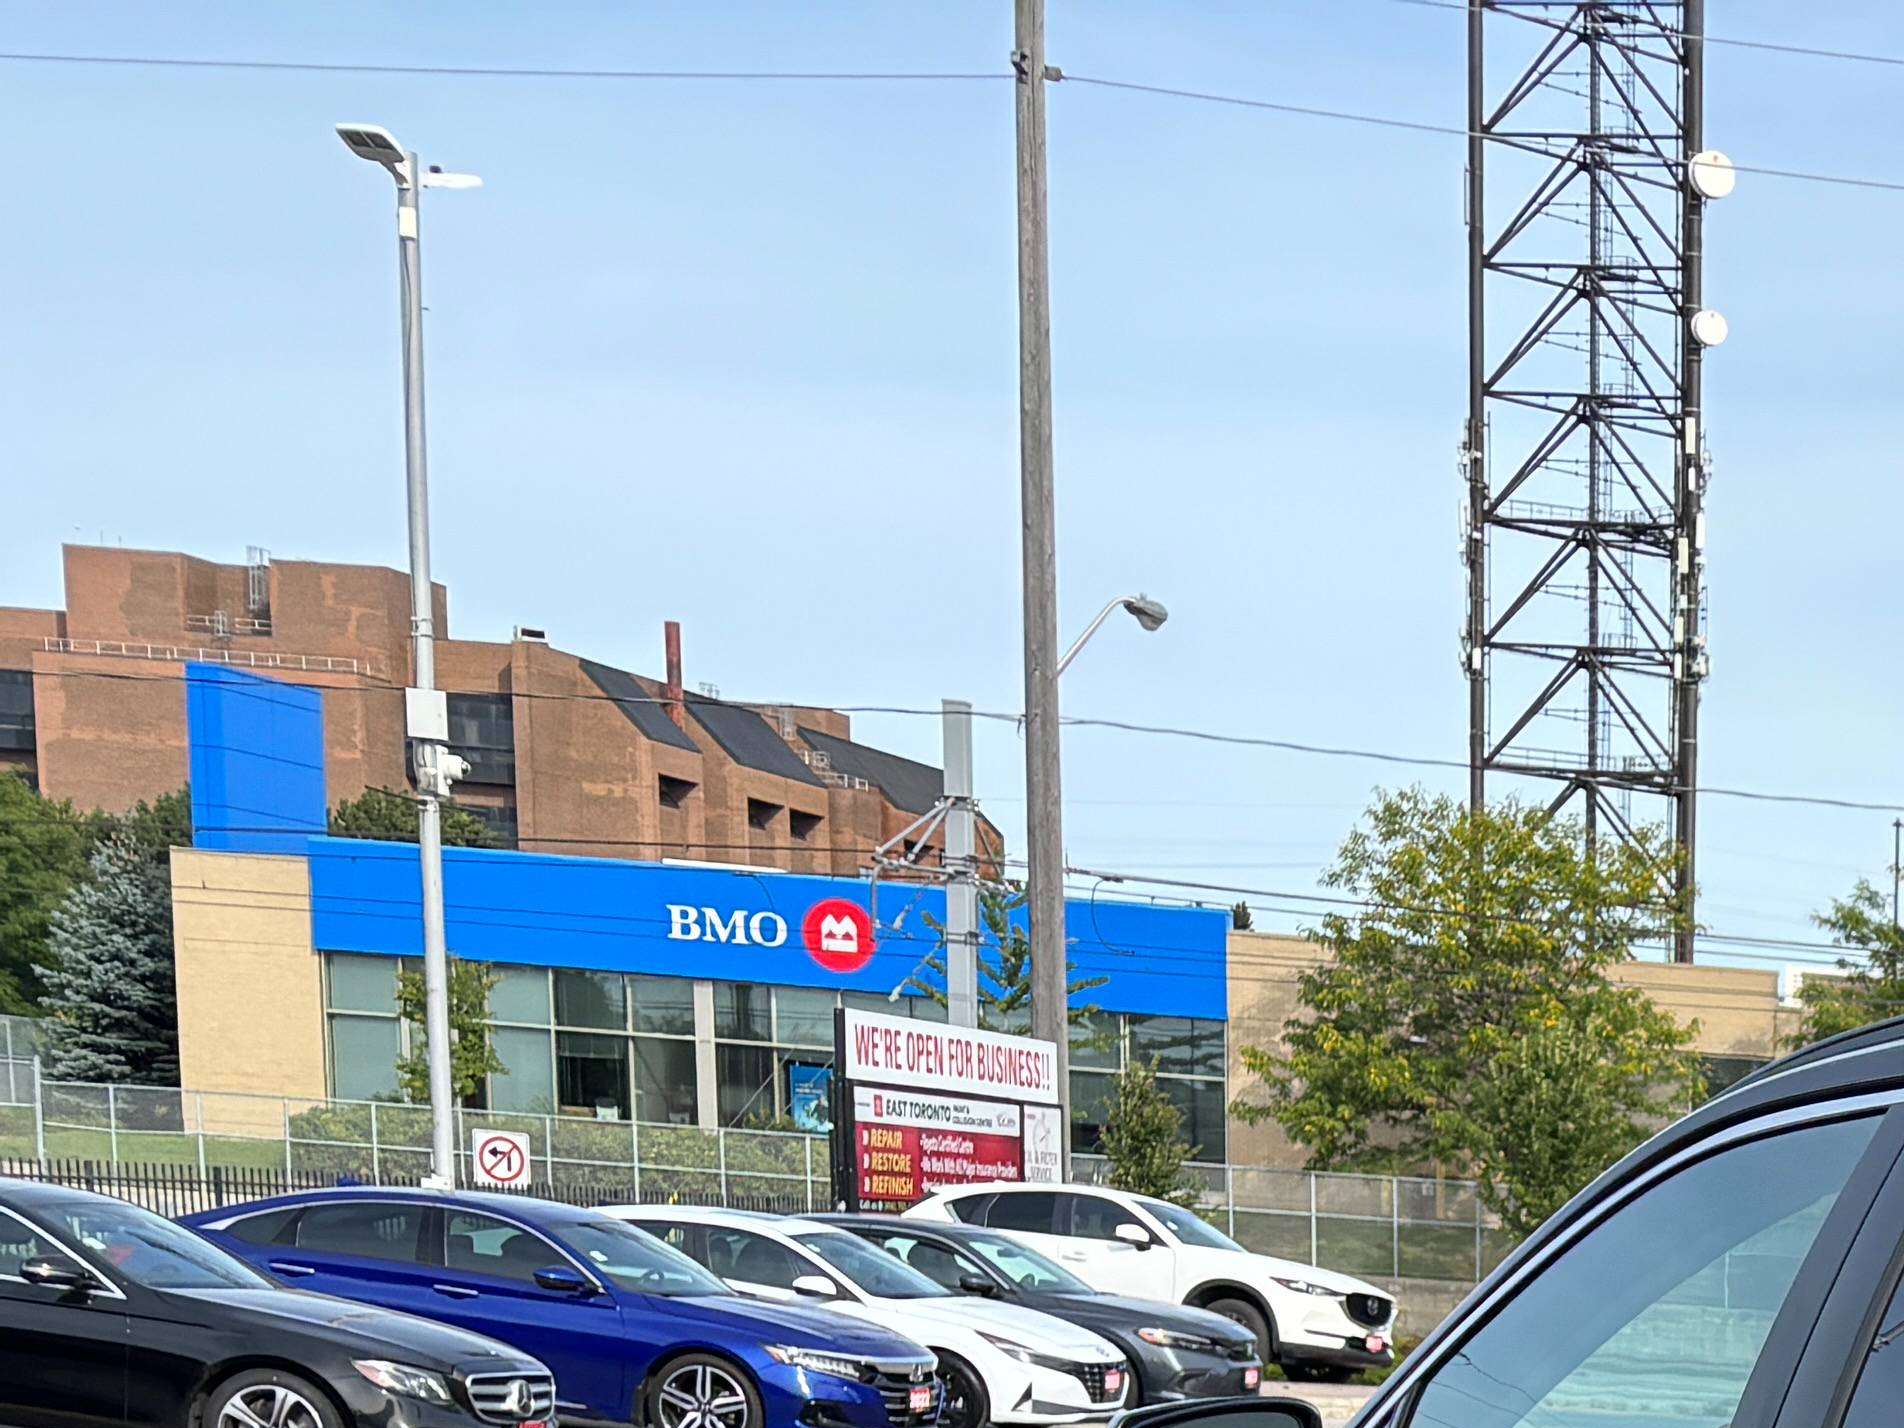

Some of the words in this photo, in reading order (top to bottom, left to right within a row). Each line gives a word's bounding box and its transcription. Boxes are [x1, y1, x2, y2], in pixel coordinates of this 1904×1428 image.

[666, 904, 788, 947] BMO
[854, 1024, 902, 1070] WE'RE
[906, 1031, 944, 1076] OPEN
[949, 1038, 974, 1080] FOR
[977, 1042, 1050, 1091] BUSINESS!!
[886, 1099, 907, 1118] EAST
[909, 1101, 950, 1123] TORONTO
[871, 1130, 902, 1149] REPAIR
[871, 1152, 912, 1173] RESTORE
[872, 1175, 914, 1196] REFINISH
